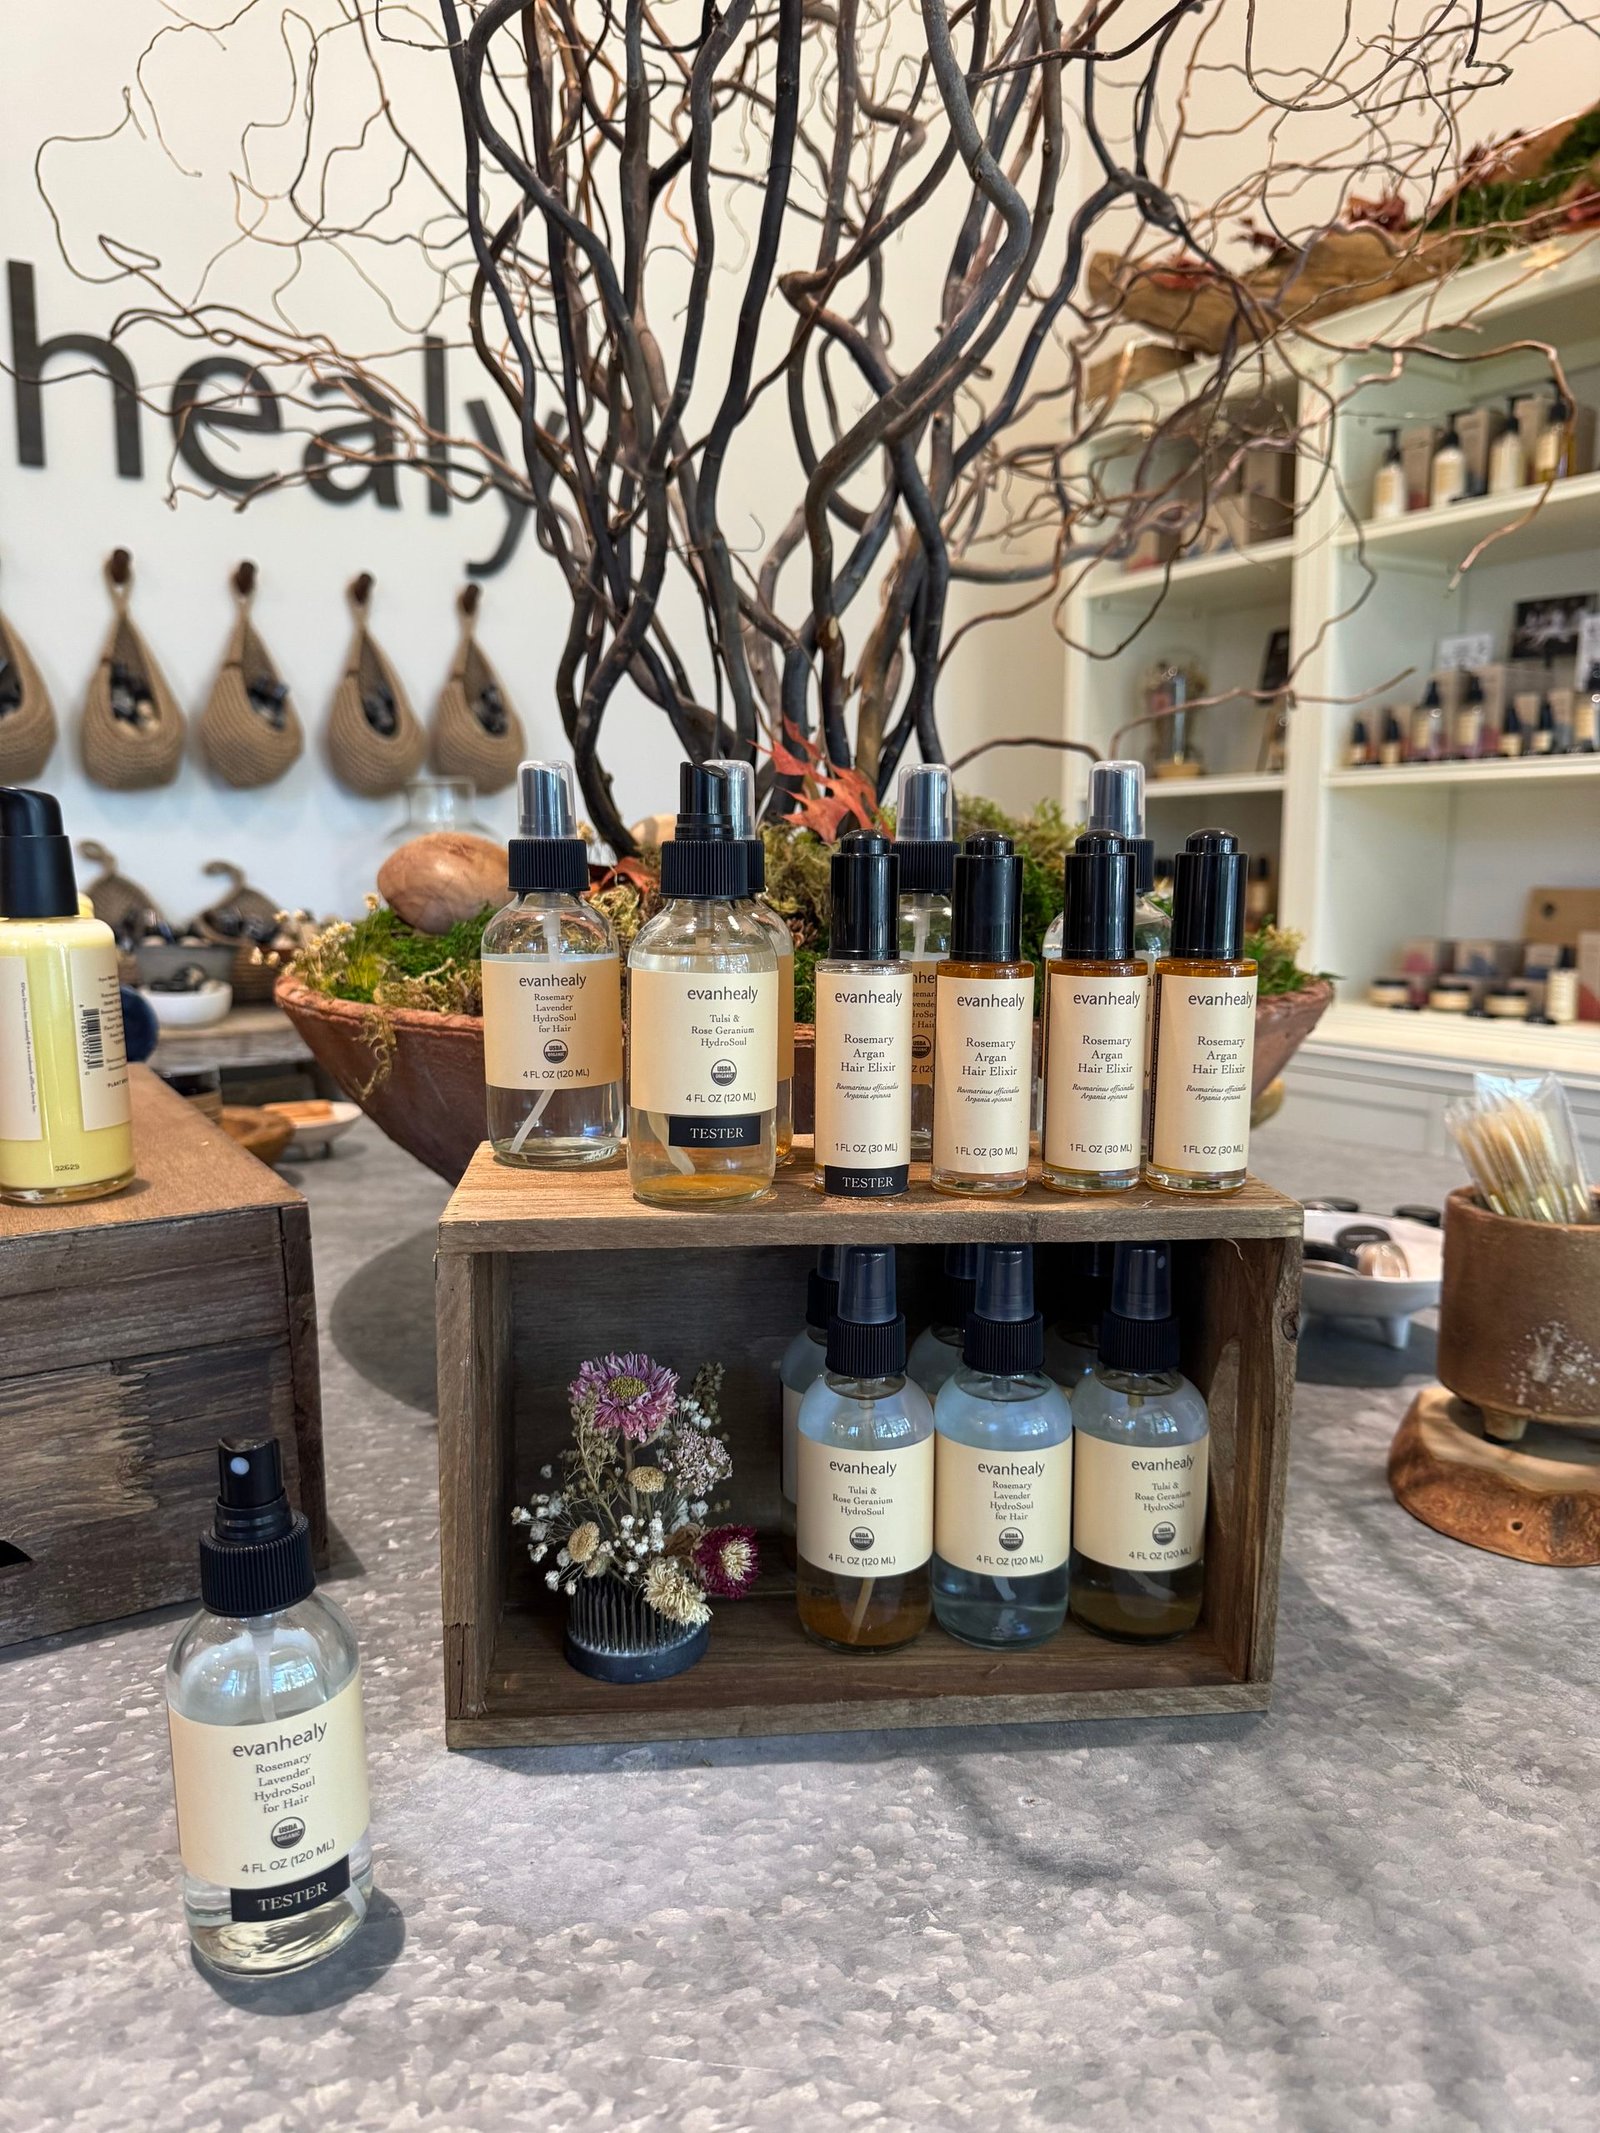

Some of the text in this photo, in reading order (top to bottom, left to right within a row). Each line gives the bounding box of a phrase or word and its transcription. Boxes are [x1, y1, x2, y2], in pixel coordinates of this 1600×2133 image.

[7, 259, 564, 578] healy
[519, 973, 587, 989] evanhealy
[687, 986, 758, 1003] evanhealy
[835, 990, 902, 1007] evanhealy
[1073, 991, 1141, 1008] evanhealy
[1188, 992, 1254, 1008] evanhealy
[957, 994, 1025, 1010] evanhealy
[533, 1014, 577, 1023] HydroSoul
[710, 1014, 730, 1022] Tulsi
[691, 1026, 754, 1034] Rose Geranium
[701, 1038, 747, 1048] HydroSoul
[844, 1034, 894, 1046] Rosemary
[966, 1037, 1016, 1050] Rosemary
[1082, 1035, 1132, 1047] Rosemary
[1198, 1036, 1245, 1048] Rosemary
[853, 1049, 885, 1061] Argan
[975, 1053, 1007, 1064] Argan
[1092, 1051, 1123, 1062] Argan
[1207, 1051, 1237, 1062] Argan
[841, 1063, 896, 1072] Hair Elixir
[962, 1066, 1017, 1076] Hair Elixir
[1078, 1064, 1133, 1074] Hair Elixir
[1192, 1065, 1245, 1074] Hair Elixir
[557, 1070, 573, 1079] (120
[576, 1069, 590, 1077] ML)
[686, 1092, 756, 1104] 4 FL OZ (120 ML)
[690, 1128, 744, 1139] TESTER
[835, 1142, 897, 1154] 1 FL OZ (30 ML)
[955, 1146, 1018, 1158] 1 FL OZ (30 ML)
[1076, 1144, 1086, 1152] FL
[1089, 1145, 1102, 1153] OZ
[1105, 1145, 1118, 1154] (30
[1120, 1144, 1132, 1153] ML)
[1183, 1145, 1187, 1153] 1
[1189, 1145, 1200, 1154] FL
[1203, 1145, 1216, 1154] OZ
[1219, 1146, 1232, 1156] (30
[843, 1176, 893, 1189] TESTER
[829, 1461, 897, 1477] evanhealy
[1131, 1455, 1195, 1471] evanhealy
[978, 1462, 1045, 1477] evanhealy
[848, 1486, 868, 1495] Tulsi
[992, 1482, 1032, 1490] Rosemary
[1152, 1483, 1171, 1491] Tulsi
[832, 1494, 893, 1506] Rose Geranium
[994, 1492, 1031, 1500] Lavender
[1135, 1490, 1191, 1501] Rose Geranium
[841, 1506, 885, 1516] HydroSoul
[990, 1501, 1034, 1511] HydroSoul
[1143, 1501, 1185, 1513] HydroSoul
[995, 1512, 1007, 1521] for
[828, 1553, 896, 1567] 4 FL OZ (120 ML)
[1129, 1547, 1192, 1561] 4 FL OZ (120 ML)
[976, 1555, 1044, 1567] 4 FL OZ (120 ML)
[232, 1722, 327, 1757] evanhealy
[255, 1752, 312, 1774] Rosemary
[258, 1766, 311, 1787] Lavender
[254, 1777, 316, 1802] HydroSoul
[263, 1795, 309, 1813] for Hair
[279, 1823, 298, 1834] USDA
[241, 1838, 335, 1873] 4 FL OZ (120 ML)
[258, 1881, 329, 1911] TESTER
